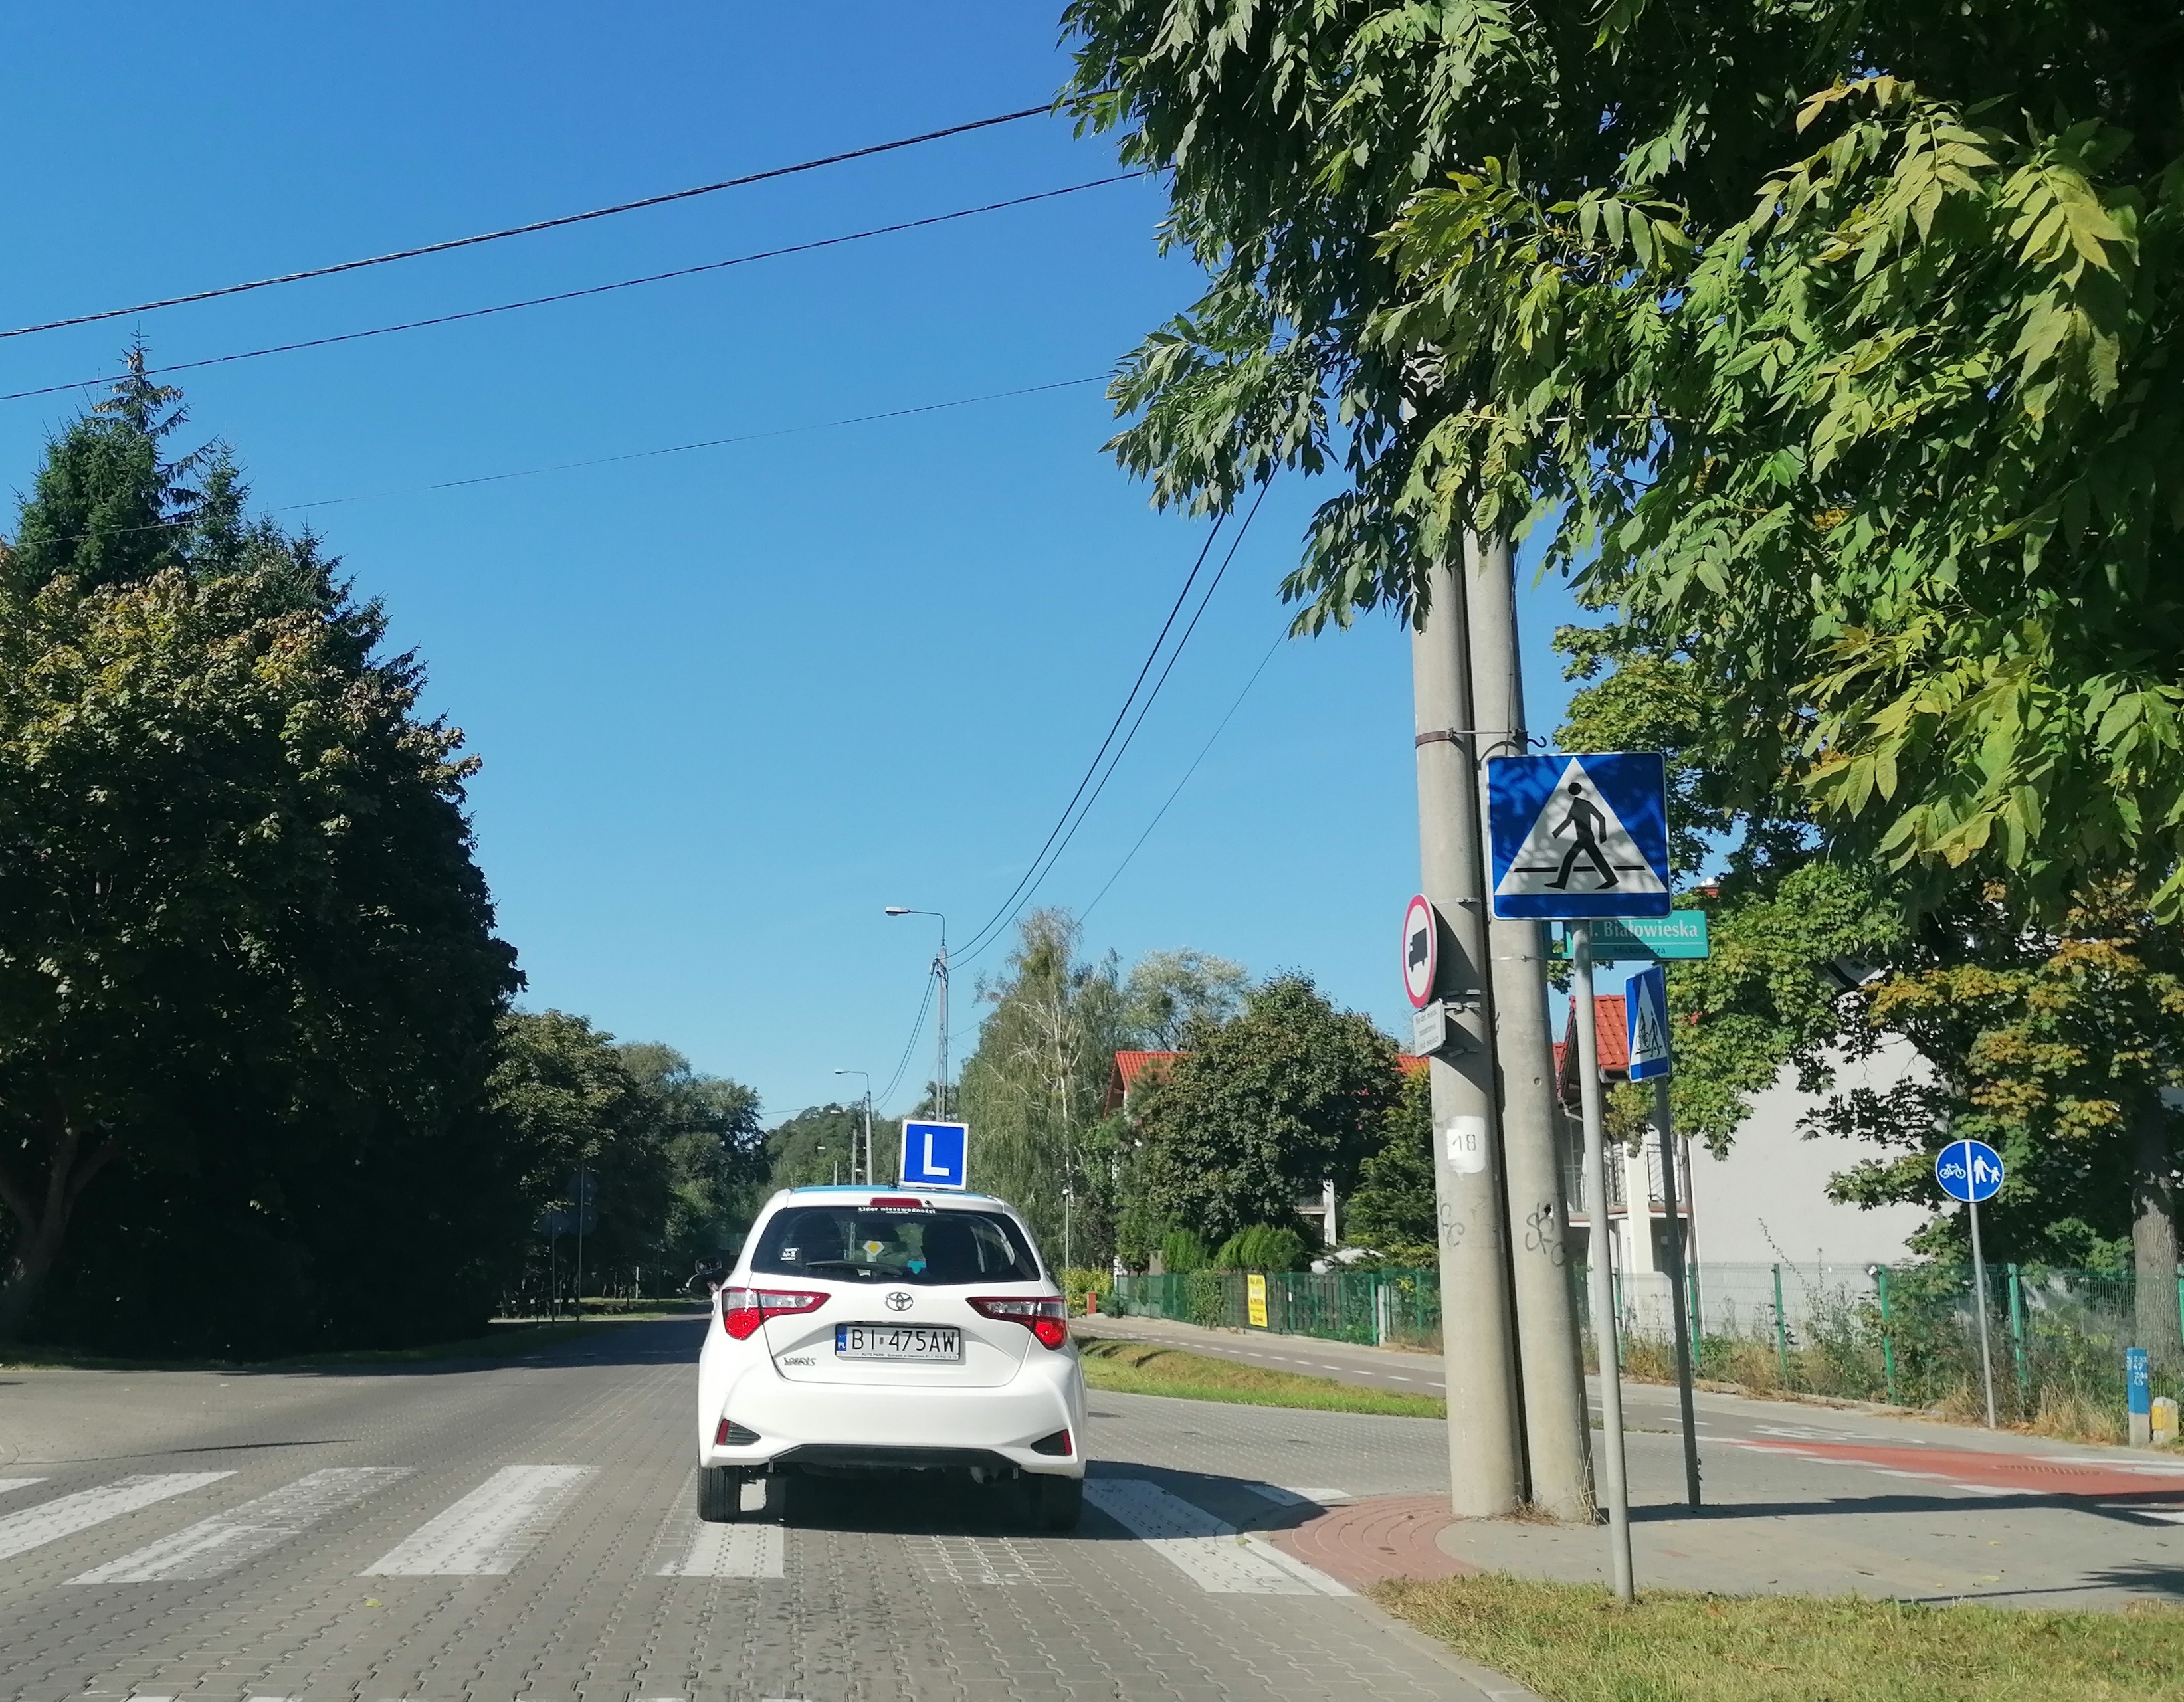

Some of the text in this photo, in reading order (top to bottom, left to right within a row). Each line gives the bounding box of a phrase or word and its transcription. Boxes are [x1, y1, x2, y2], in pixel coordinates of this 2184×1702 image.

[1604, 919, 1698, 937] Białowieska
[1452, 1134, 1476, 1151] 18
[923, 1133, 949, 1176] L
[852, 1329, 955, 1353] BI 475AW
